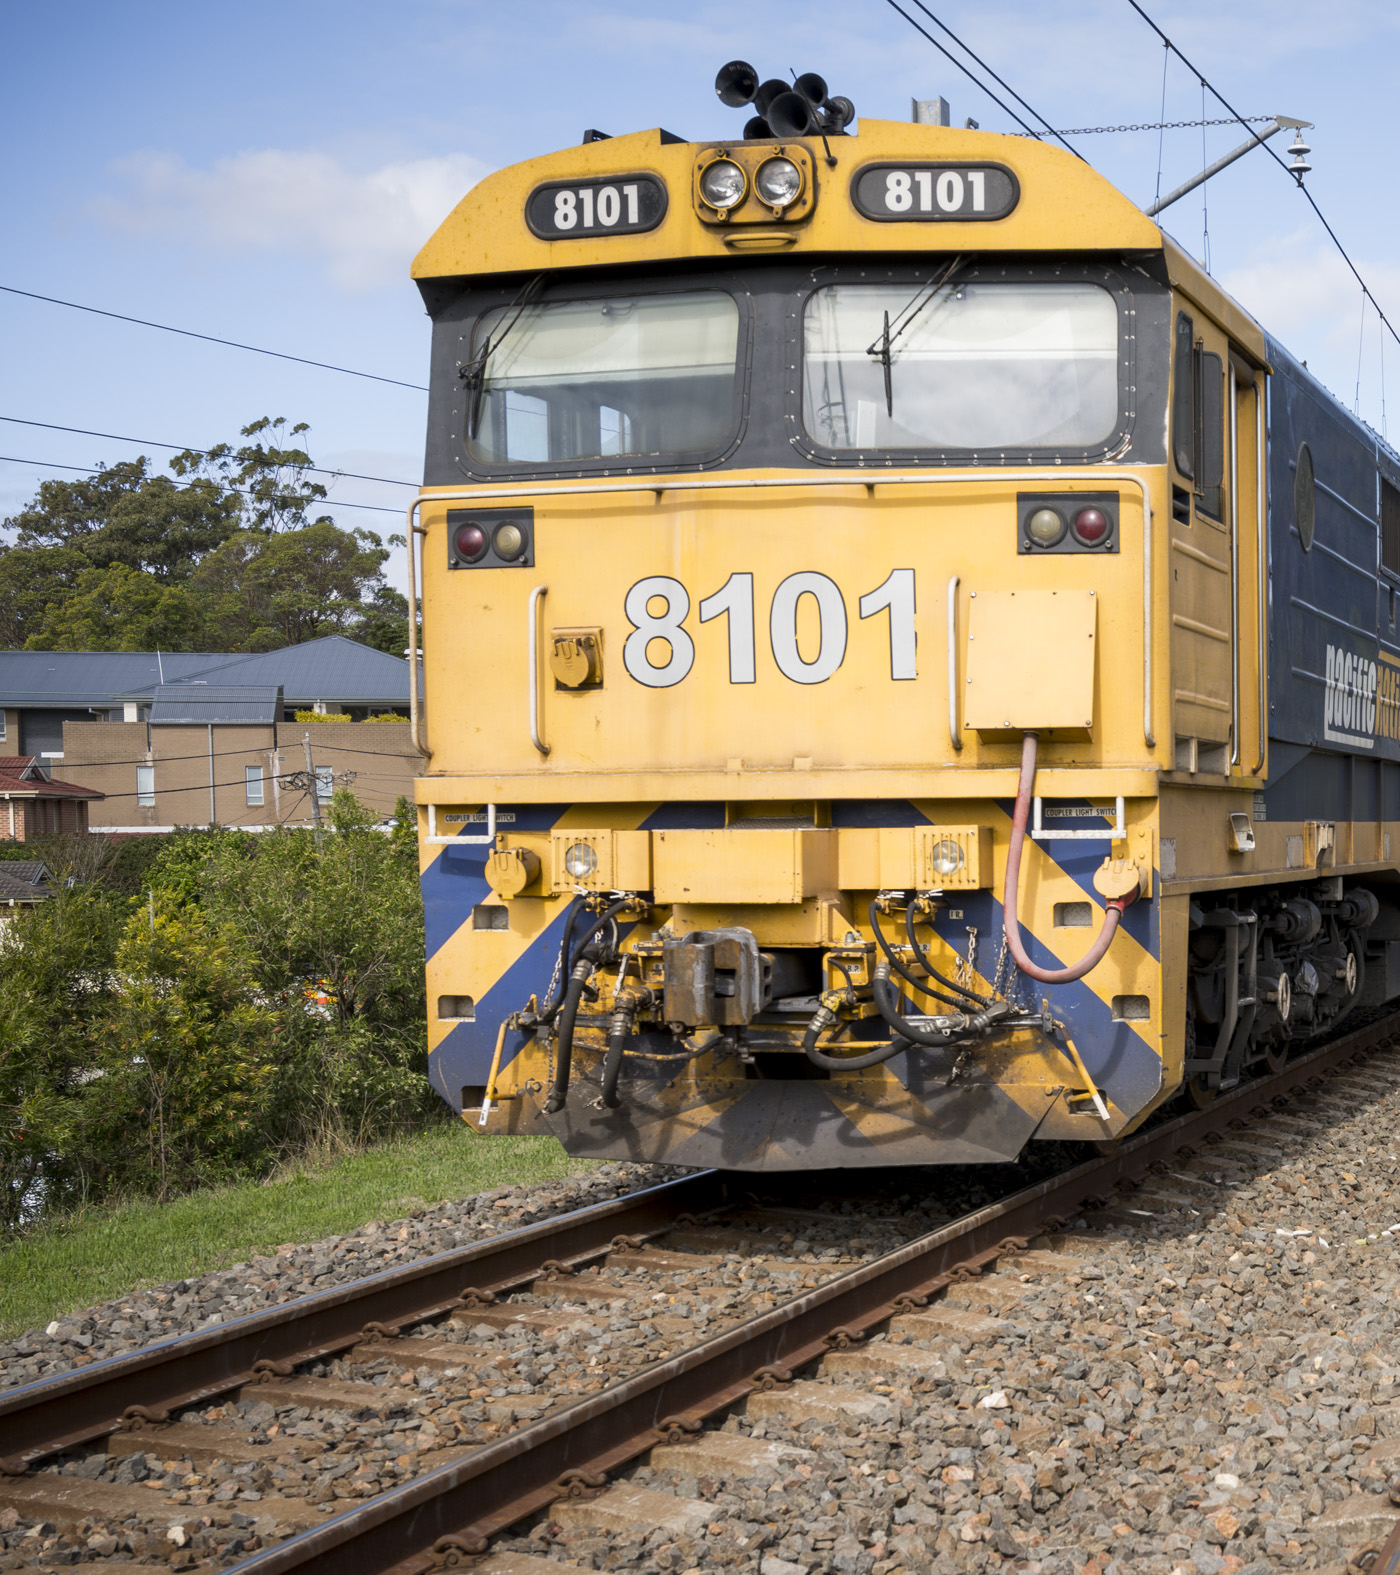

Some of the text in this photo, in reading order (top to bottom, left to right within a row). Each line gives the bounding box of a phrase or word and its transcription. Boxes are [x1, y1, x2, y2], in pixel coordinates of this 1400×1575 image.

[553, 184, 639, 230] 8101
[884, 171, 985, 212] 8101
[622, 568, 918, 688] 8101
[1324, 644, 1377, 748] pacific
[445, 814, 470, 822] COUPLER
[1046, 808, 1073, 816] COUPLER
[1075, 808, 1093, 816] LIGHT
